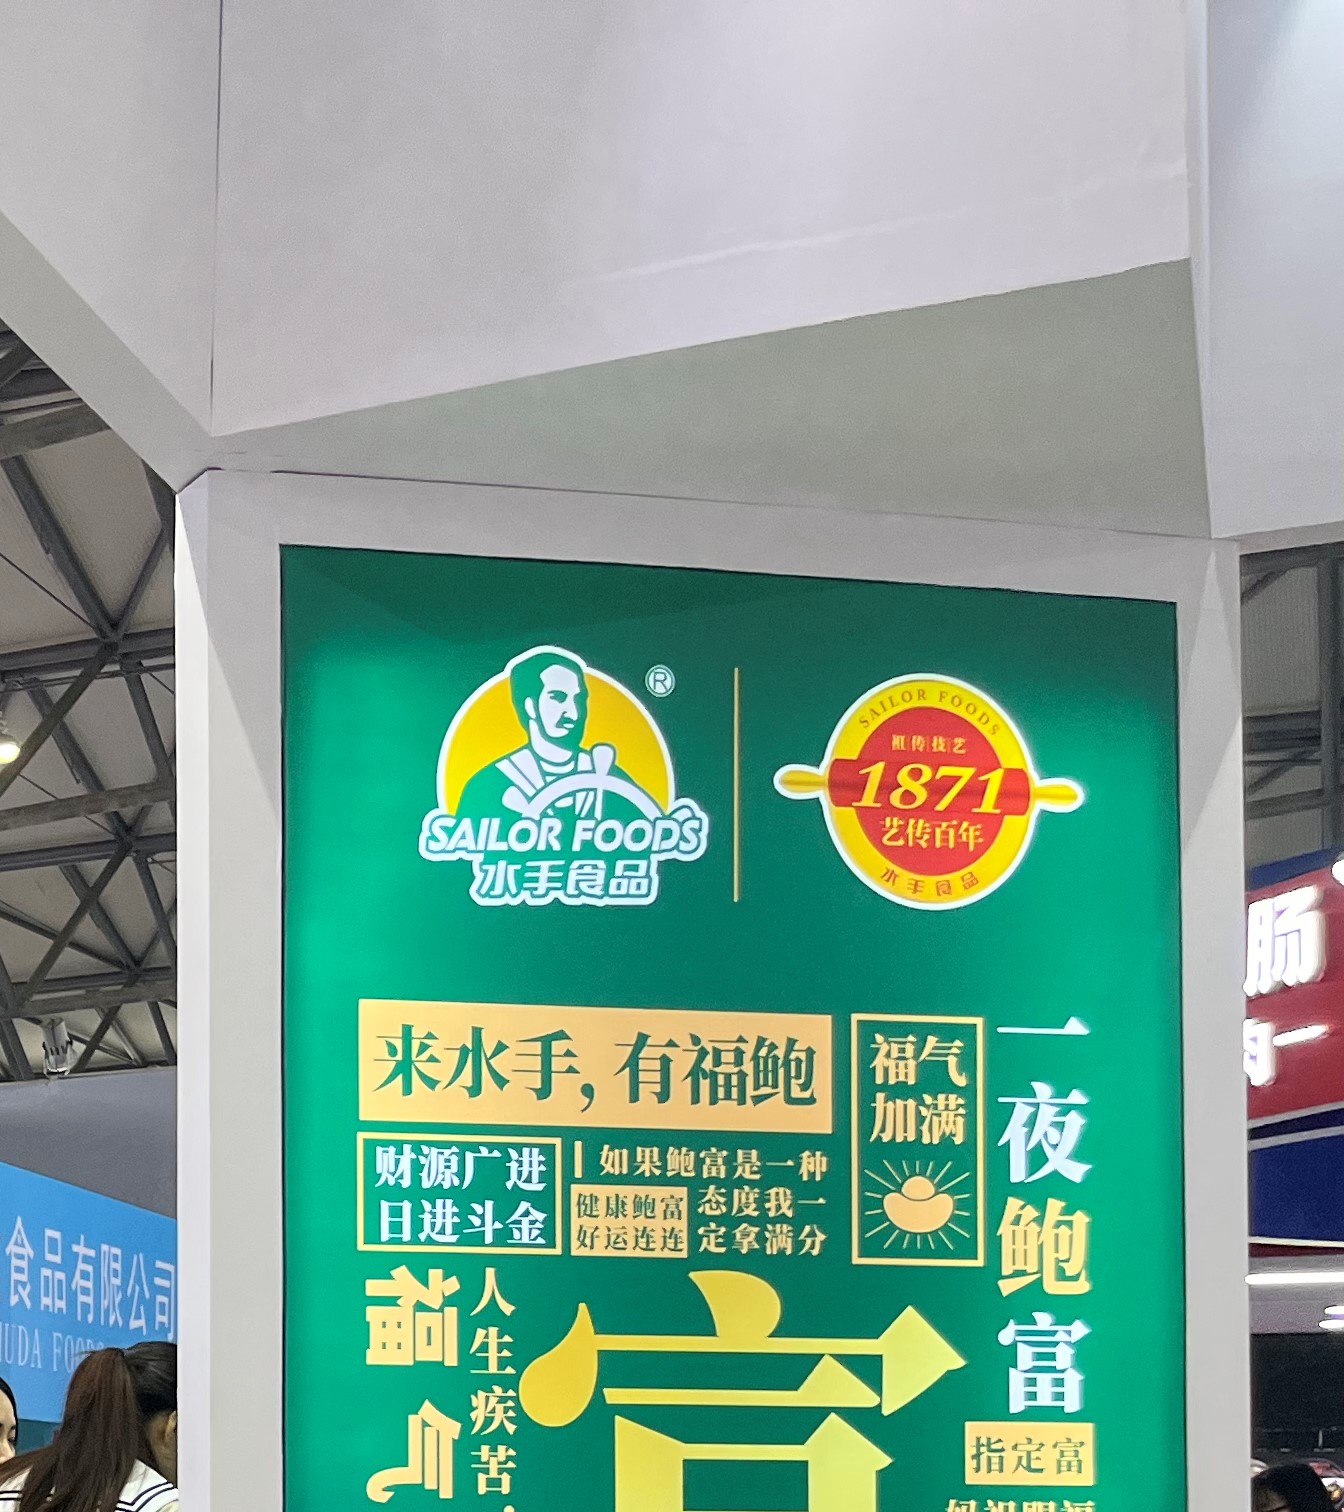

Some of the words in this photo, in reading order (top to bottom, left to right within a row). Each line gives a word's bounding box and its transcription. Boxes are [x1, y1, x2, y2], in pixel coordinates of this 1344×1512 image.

[858, 689, 928, 730] SAILOR
[938, 689, 1001, 736] FOODS
[851, 760, 1005, 815] 1871
[427, 816, 563, 852] SAILOR
[571, 816, 703, 853] FOODS
[880, 816, 984, 853] 艺传百年
[480, 859, 650, 900] 水手食品
[880, 867, 980, 897] 水手食品
[869, 1033, 968, 1090] 福气
[870, 1092, 967, 1147] 加满
[373, 1145, 547, 1191] 财源广进
[599, 1145, 830, 1183] 如果鲍富是一种
[377, 1197, 548, 1246] 日进斗金
[575, 1191, 686, 1221] 健康鲍富
[697, 1186, 828, 1221] 态度我一
[575, 1223, 686, 1255] 好运连连
[697, 1222, 828, 1258] 定拿满分
[969, 1435, 1088, 1476] 指定富
